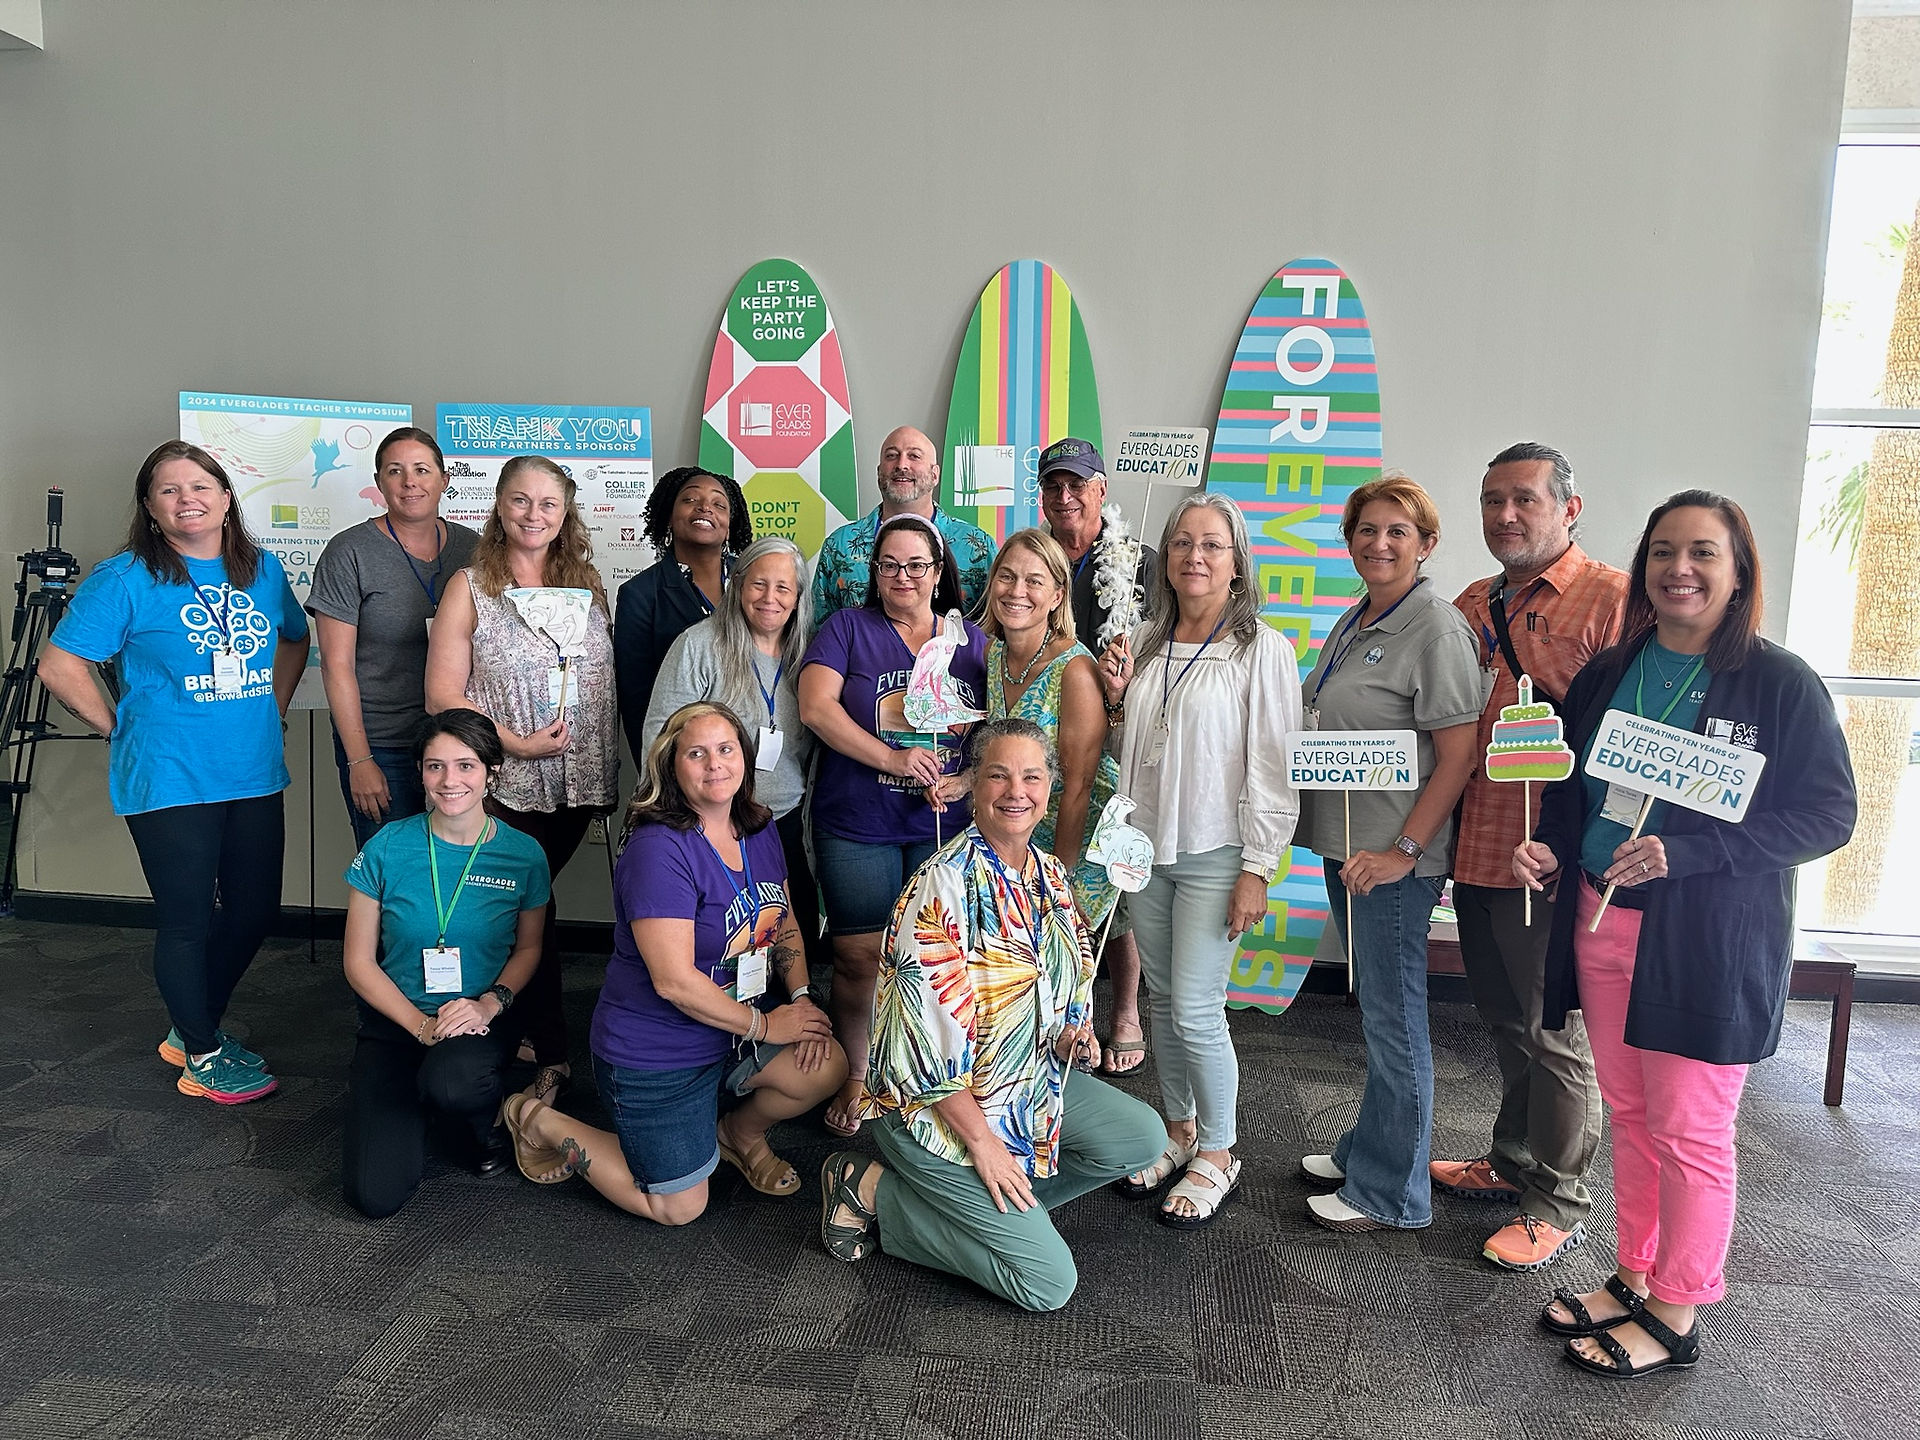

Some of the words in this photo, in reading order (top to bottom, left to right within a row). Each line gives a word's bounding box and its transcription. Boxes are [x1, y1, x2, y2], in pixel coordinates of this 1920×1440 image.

[757, 280, 799, 293] LET'S
[741, 296, 781, 309] KEEP
[785, 295, 816, 308] THE
[753, 311, 805, 325] PARTY
[753, 327, 805, 340] GOING
[188, 397, 216, 406] 2024
[220, 399, 290, 410] EVERGLADES
[293, 403, 342, 412] TEACHER
[344, 406, 407, 416] SYMPOSIUM
[776, 404, 811, 419] EVER
[444, 415, 565, 440] THANK
[568, 418, 641, 442] YOU
[776, 420, 811, 429] GLADES
[472, 441, 496, 449] OUR
[501, 441, 560, 450] PARTNERS
[563, 442, 572, 450] &
[576, 442, 637, 451] SPONSORS
[1120, 442, 1199, 458] EVERGLADES
[993, 449, 1013, 458] THE
[605, 481, 646, 489] COLLIER
[752, 501, 800, 513] DON'T
[756, 517, 796, 528] STOP
[235, 639, 254, 650] CS
[1625, 720, 1680, 742] CELEBRATING
[1682, 737, 1699, 748] TEN
[1700, 741, 1727, 757] YEARS
[1727, 751, 1741, 761] OF
[1293, 751, 1407, 765] EVERGLADES
[1607, 728, 1746, 785] EVERGLADES
